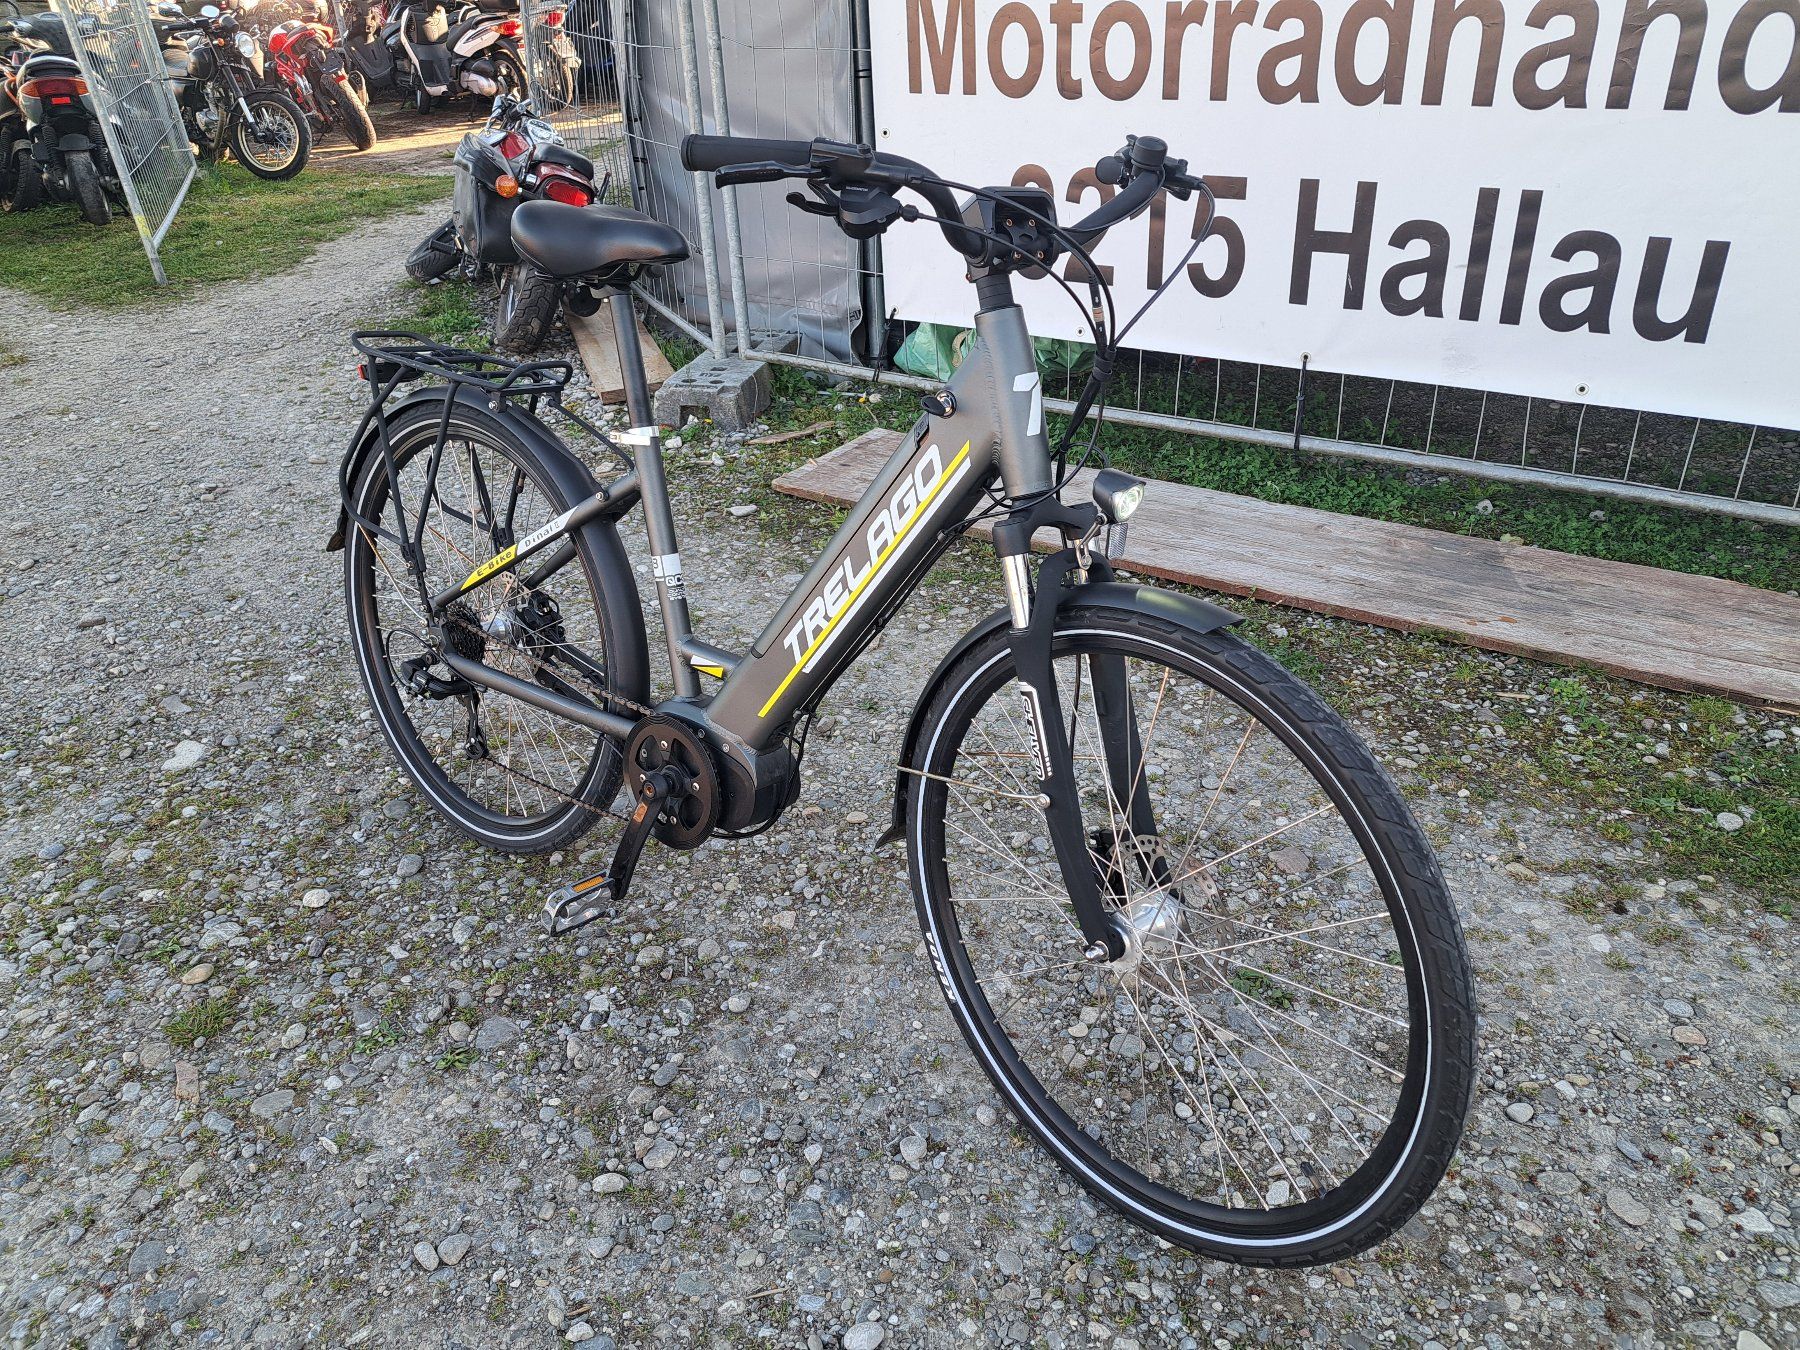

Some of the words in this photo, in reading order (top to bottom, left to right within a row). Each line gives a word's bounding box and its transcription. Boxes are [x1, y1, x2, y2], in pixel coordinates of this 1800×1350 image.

[1288, 177, 1732, 345] Hallau
[476, 550, 513, 578] E-Bike
[783, 443, 943, 665] TRELAGO
[925, 932, 956, 1001] KENDA
